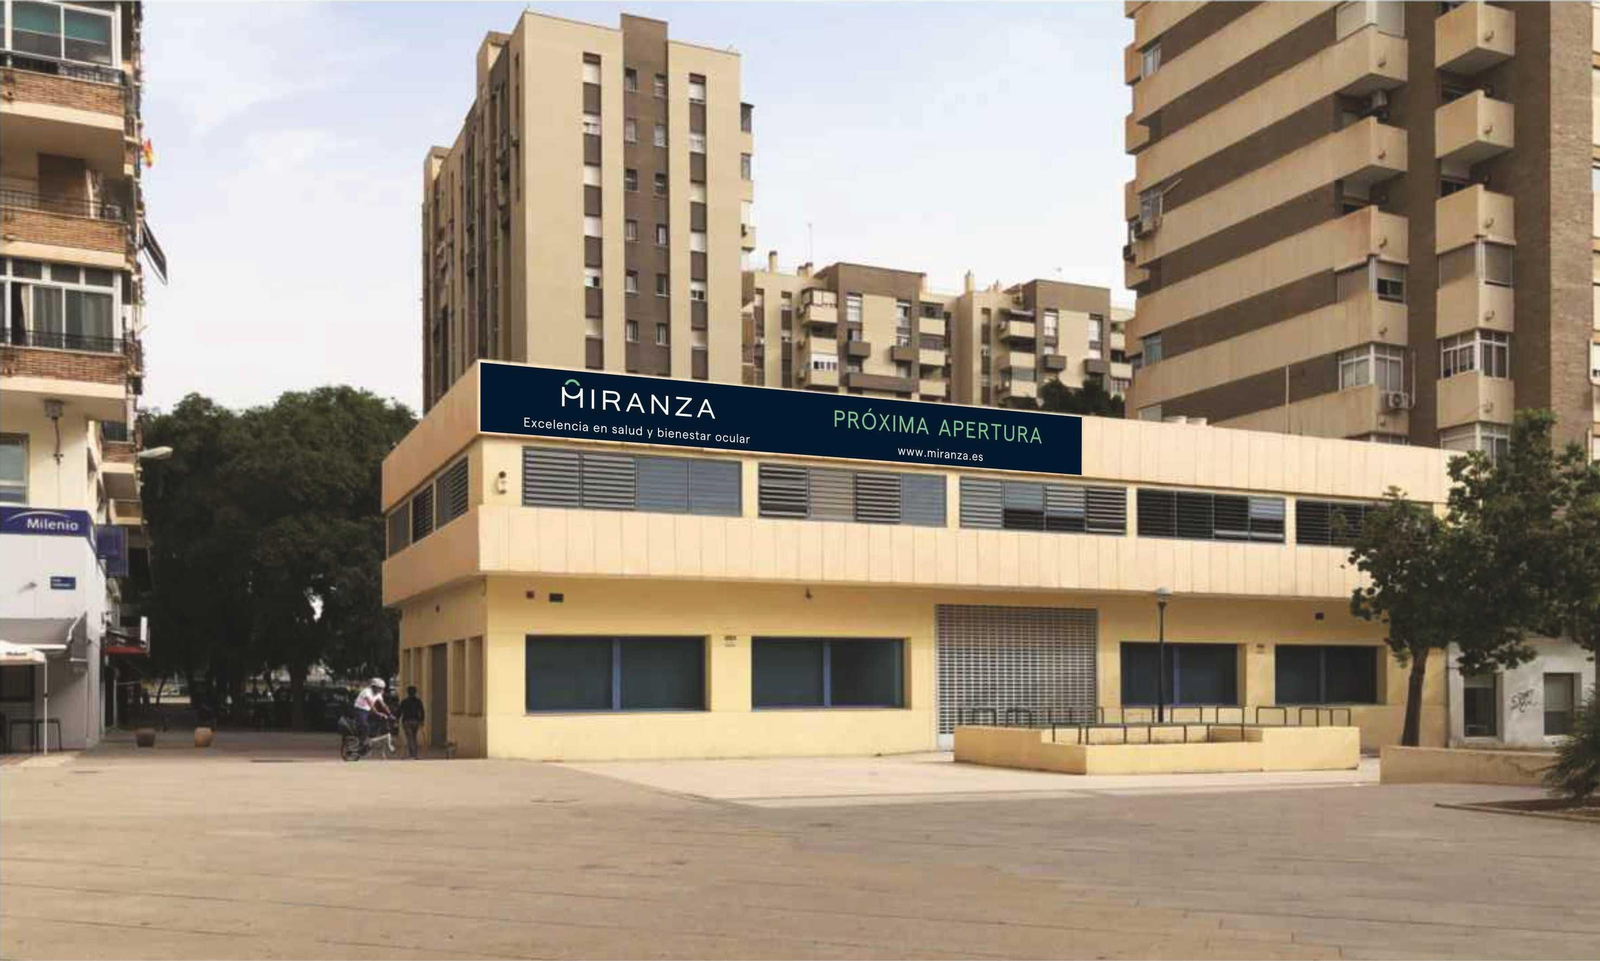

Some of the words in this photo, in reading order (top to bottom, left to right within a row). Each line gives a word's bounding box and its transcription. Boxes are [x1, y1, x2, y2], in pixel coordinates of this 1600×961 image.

[562, 380, 716, 420] MIRANZA
[523, 417, 590, 433] Excelencia
[592, 424, 608, 433] en
[611, 424, 643, 437] salud
[646, 428, 654, 439] y
[657, 427, 712, 443] bienestar
[714, 433, 751, 444] ocular
[834, 407, 930, 436] PRÓXIMA
[939, 419, 1043, 444] APERTURA
[897, 447, 984, 462] www.miranza.es
[26, 517, 79, 532] Milenio
